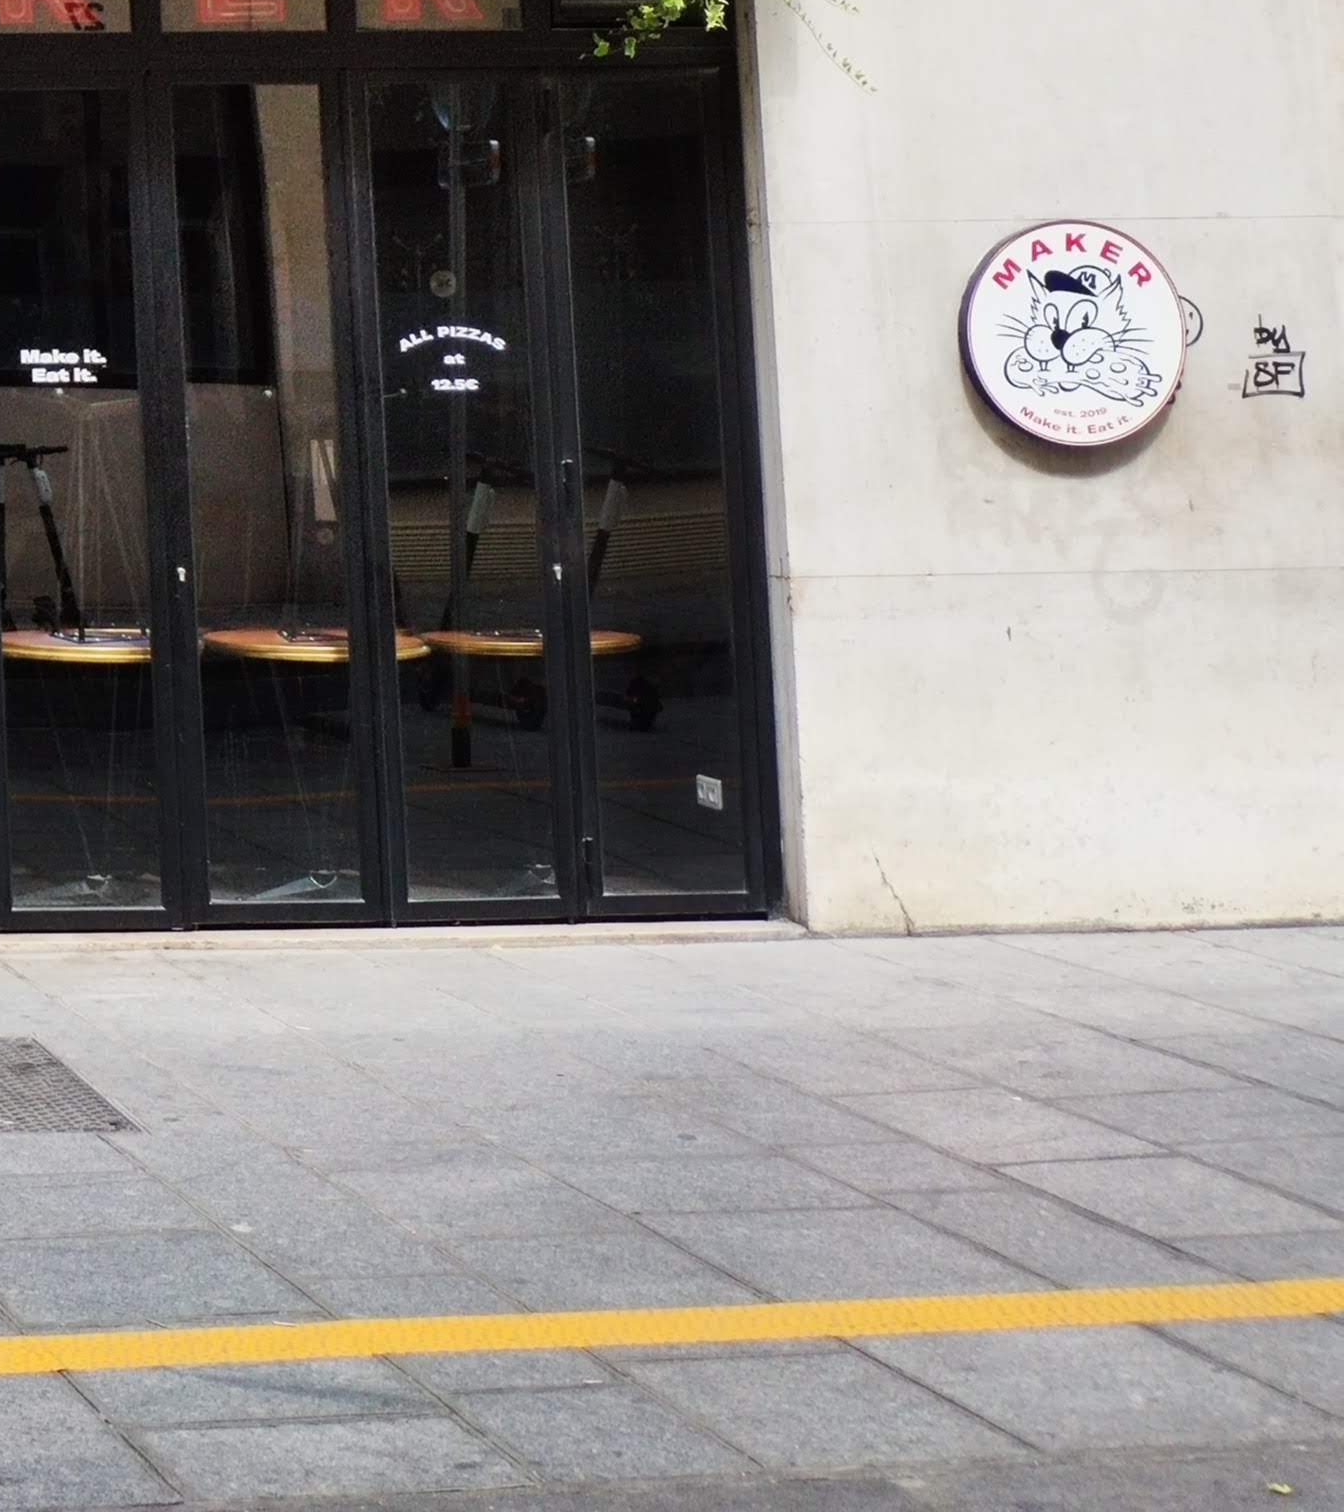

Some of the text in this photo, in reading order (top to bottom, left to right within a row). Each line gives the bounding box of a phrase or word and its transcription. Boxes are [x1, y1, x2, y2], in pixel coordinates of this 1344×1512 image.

[992, 232, 1153, 290] MAKER
[399, 325, 507, 353] ALL PIZZAS
[19, 348, 80, 364] Make
[443, 353, 466, 365] at
[31, 367, 71, 384] Eat
[430, 378, 481, 391] 12.5€
[1079, 406, 1108, 418] 2019
[1018, 406, 1134, 435] Make it. Eat it.
